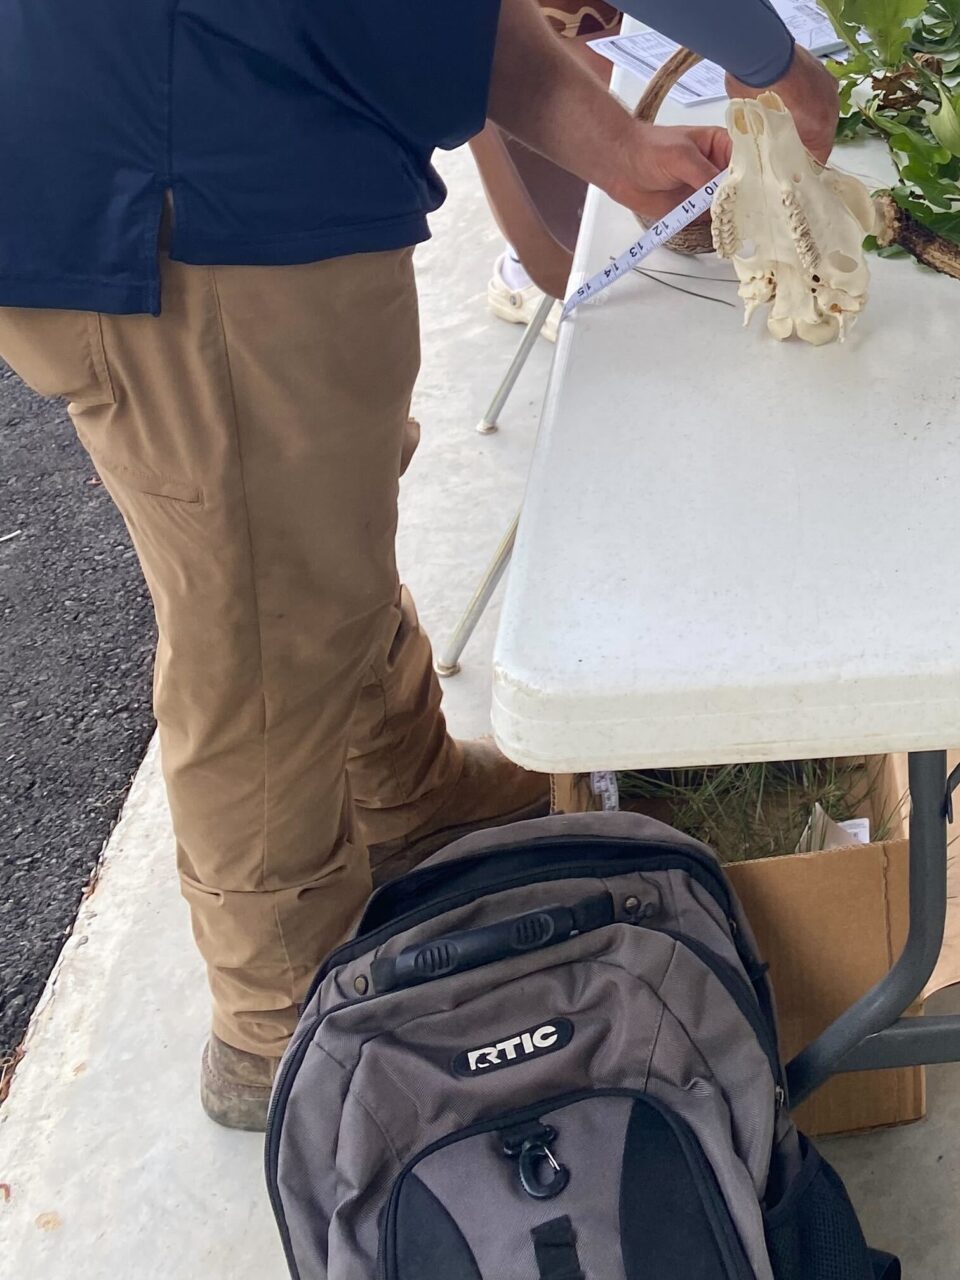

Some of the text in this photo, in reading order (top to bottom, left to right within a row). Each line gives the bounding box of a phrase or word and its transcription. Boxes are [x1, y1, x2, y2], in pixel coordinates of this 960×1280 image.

[577, 181, 719, 297] 10 11 12 13 14 15
[467, 1025, 558, 1071] RTIC
